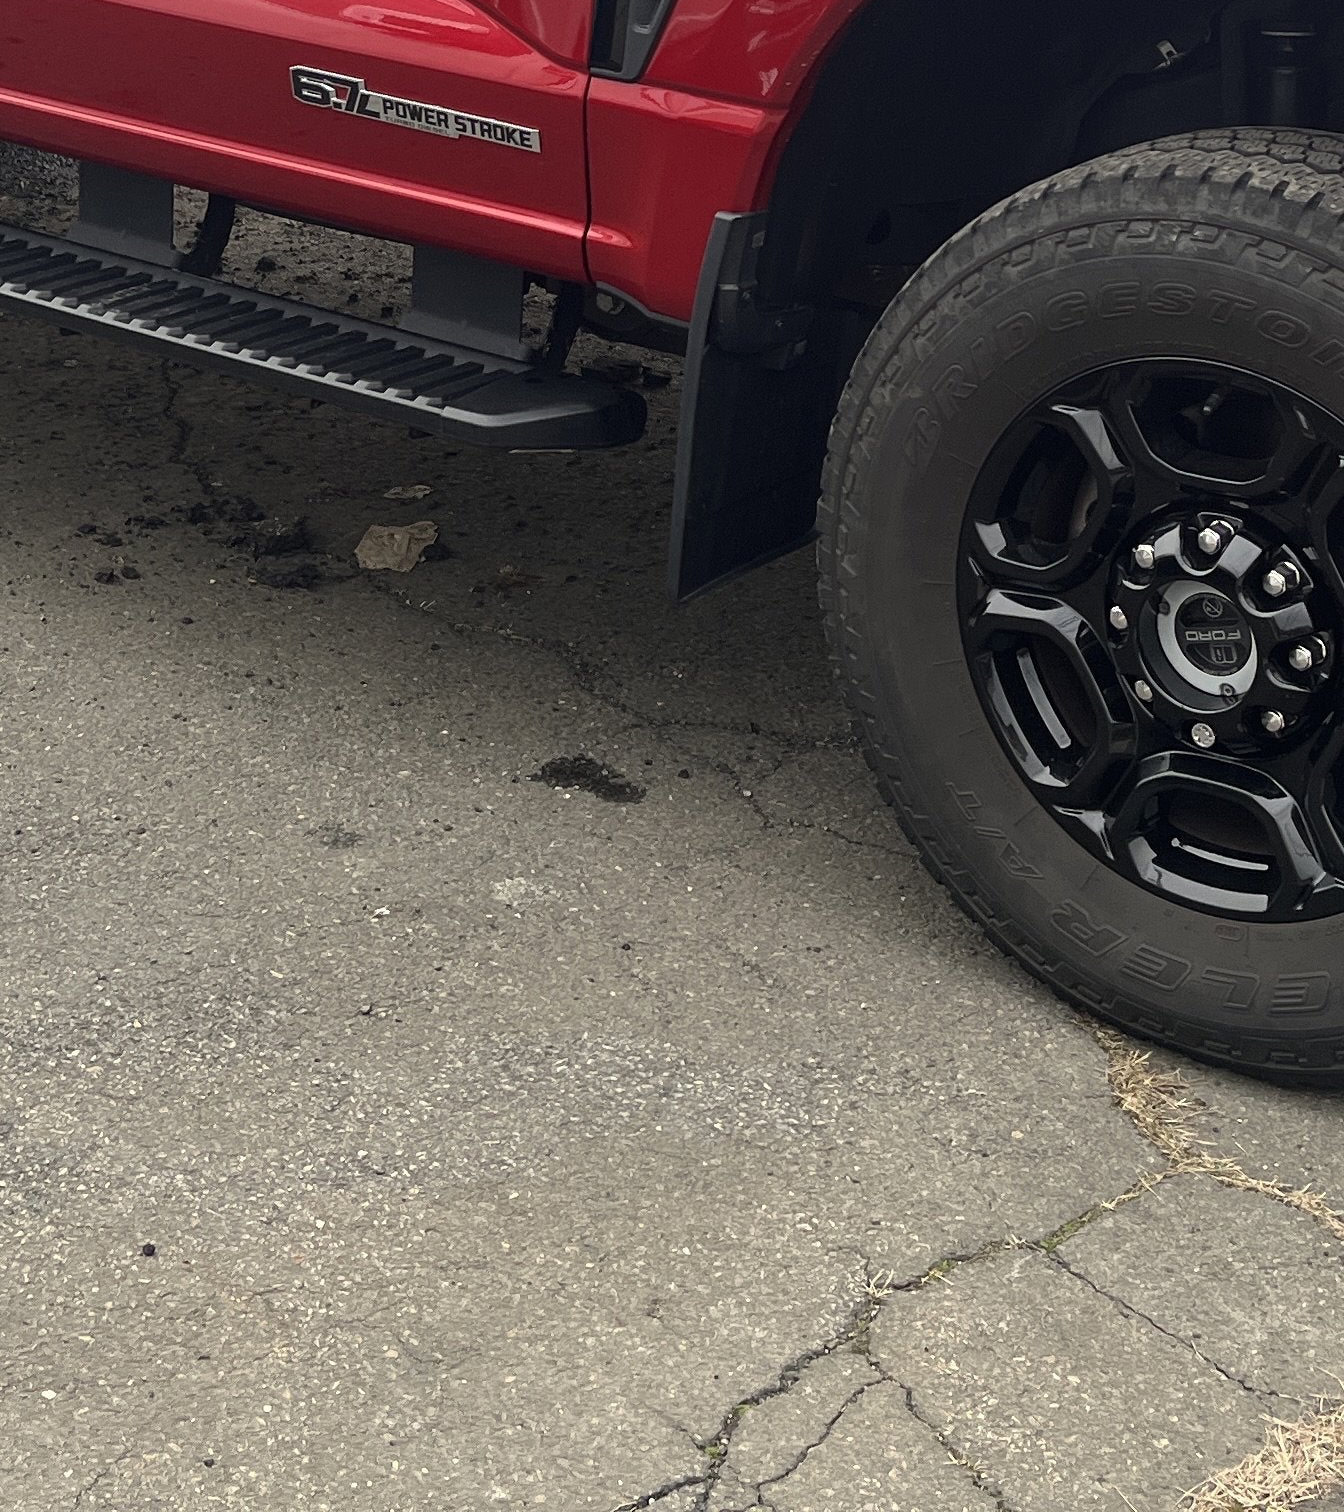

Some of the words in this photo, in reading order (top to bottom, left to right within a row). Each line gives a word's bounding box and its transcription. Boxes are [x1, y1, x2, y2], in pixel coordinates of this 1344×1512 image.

[290, 65, 381, 119] 6.7L
[382, 97, 450, 129] POWER
[454, 115, 533, 149] STROKE
[1184, 629, 1242, 641] FORD
[945, 781, 1044, 880] A/T
